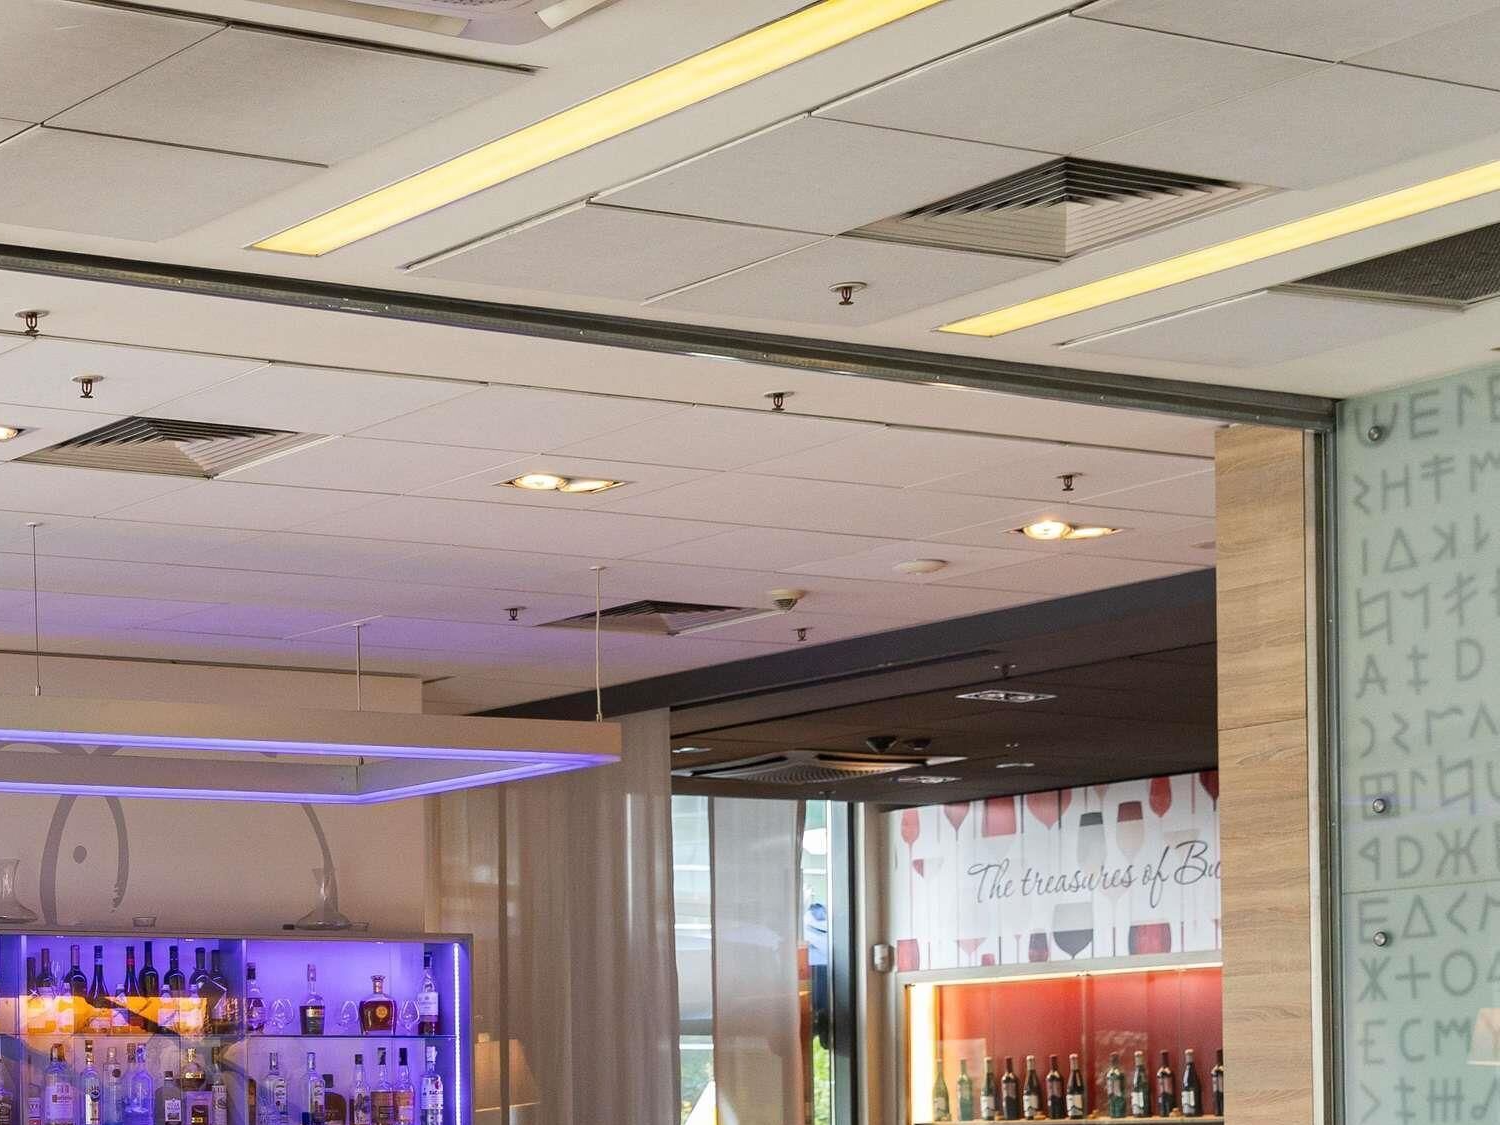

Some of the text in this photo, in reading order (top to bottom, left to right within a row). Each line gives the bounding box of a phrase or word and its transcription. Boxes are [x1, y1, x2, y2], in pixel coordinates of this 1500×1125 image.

[967, 858, 1014, 904] The
[1020, 862, 1134, 898] treasures
[1141, 845, 1170, 909] of
